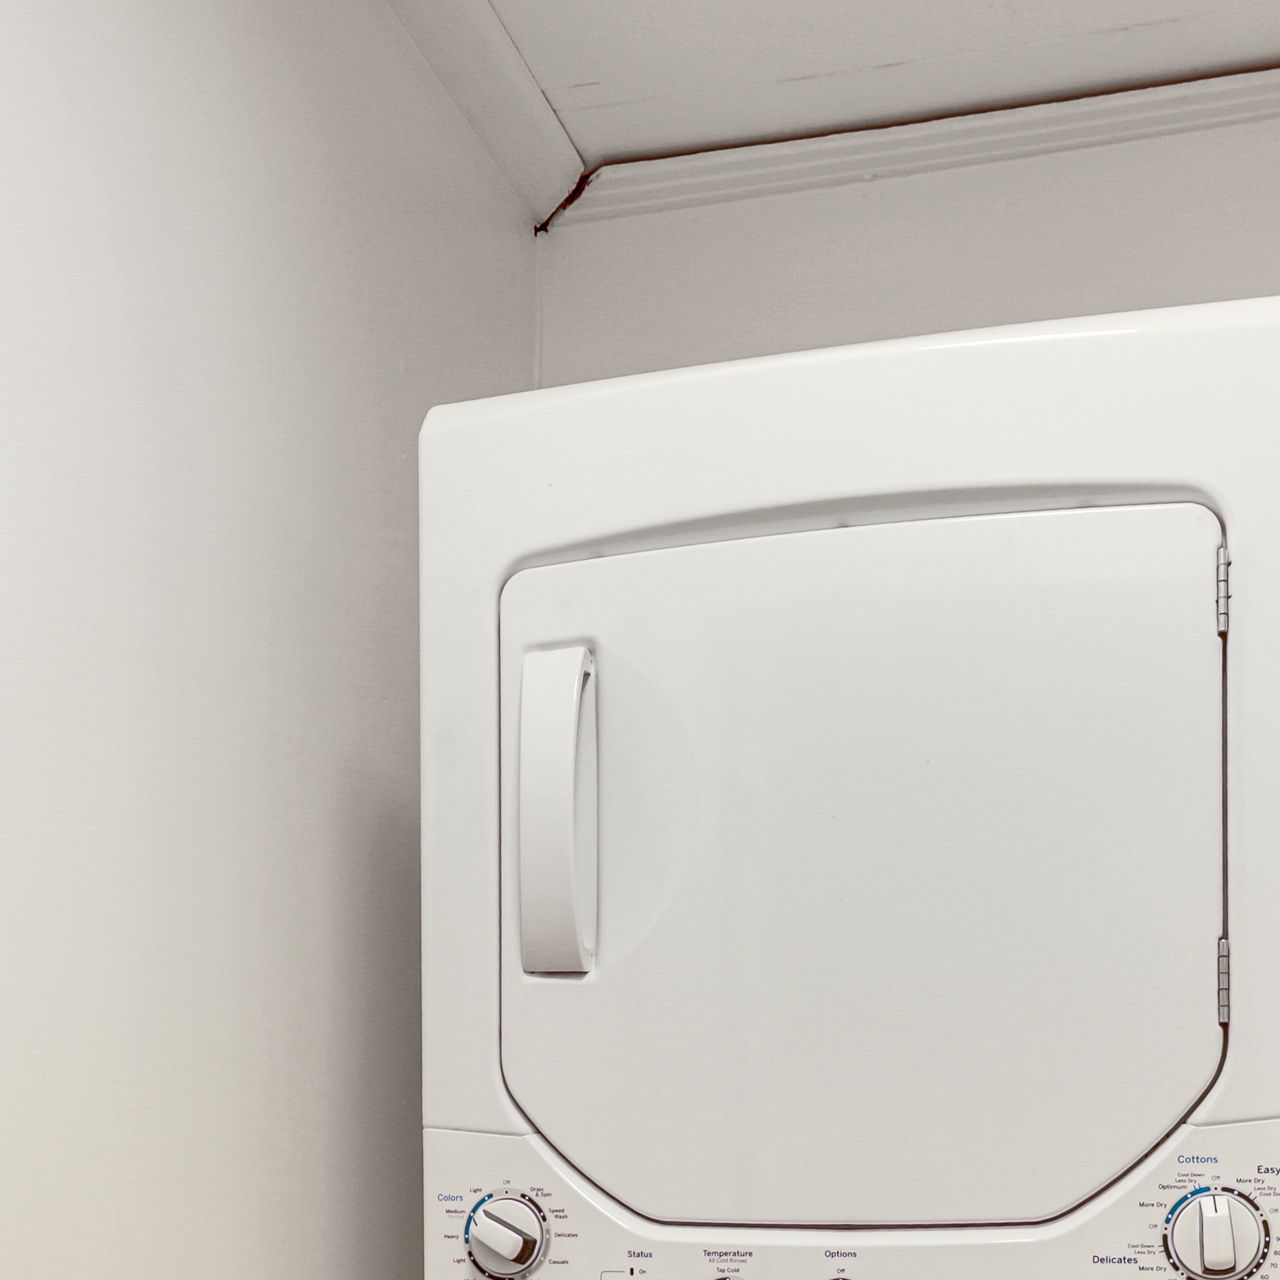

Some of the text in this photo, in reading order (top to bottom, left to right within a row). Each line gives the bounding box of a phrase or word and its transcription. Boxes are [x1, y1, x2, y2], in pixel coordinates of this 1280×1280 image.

[1177, 1155, 1218, 1164] Cottons
[1257, 1166, 1280, 1174] Easy
[437, 1193, 463, 1202] Colors
[628, 1250, 652, 1258] Status
[703, 1250, 753, 1258] Temperature
[824, 1250, 857, 1258] Options
[1092, 1255, 1138, 1264] Delicates
